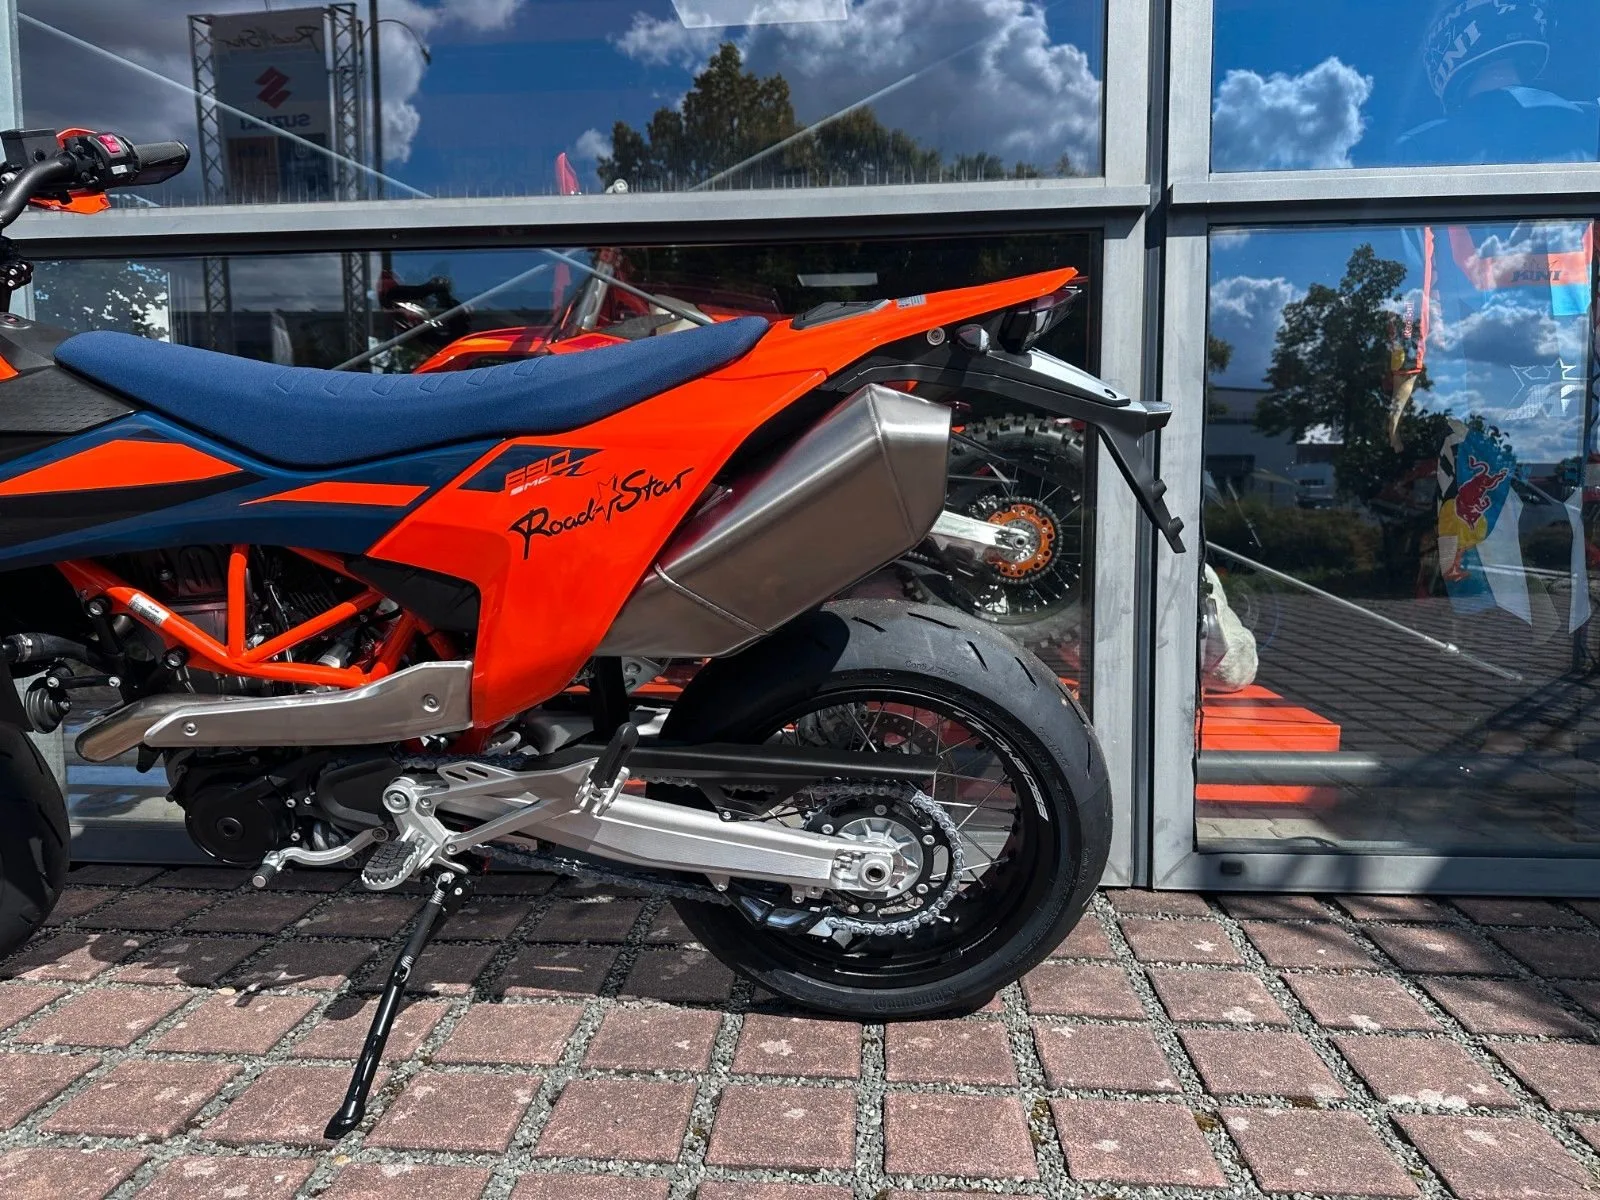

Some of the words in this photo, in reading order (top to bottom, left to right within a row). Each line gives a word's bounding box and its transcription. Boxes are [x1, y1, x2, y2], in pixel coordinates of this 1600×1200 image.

[505, 450, 570, 487] 690
[510, 475, 551, 496] SMC
[508, 498, 596, 560] Road
[616, 467, 694, 512] Star
